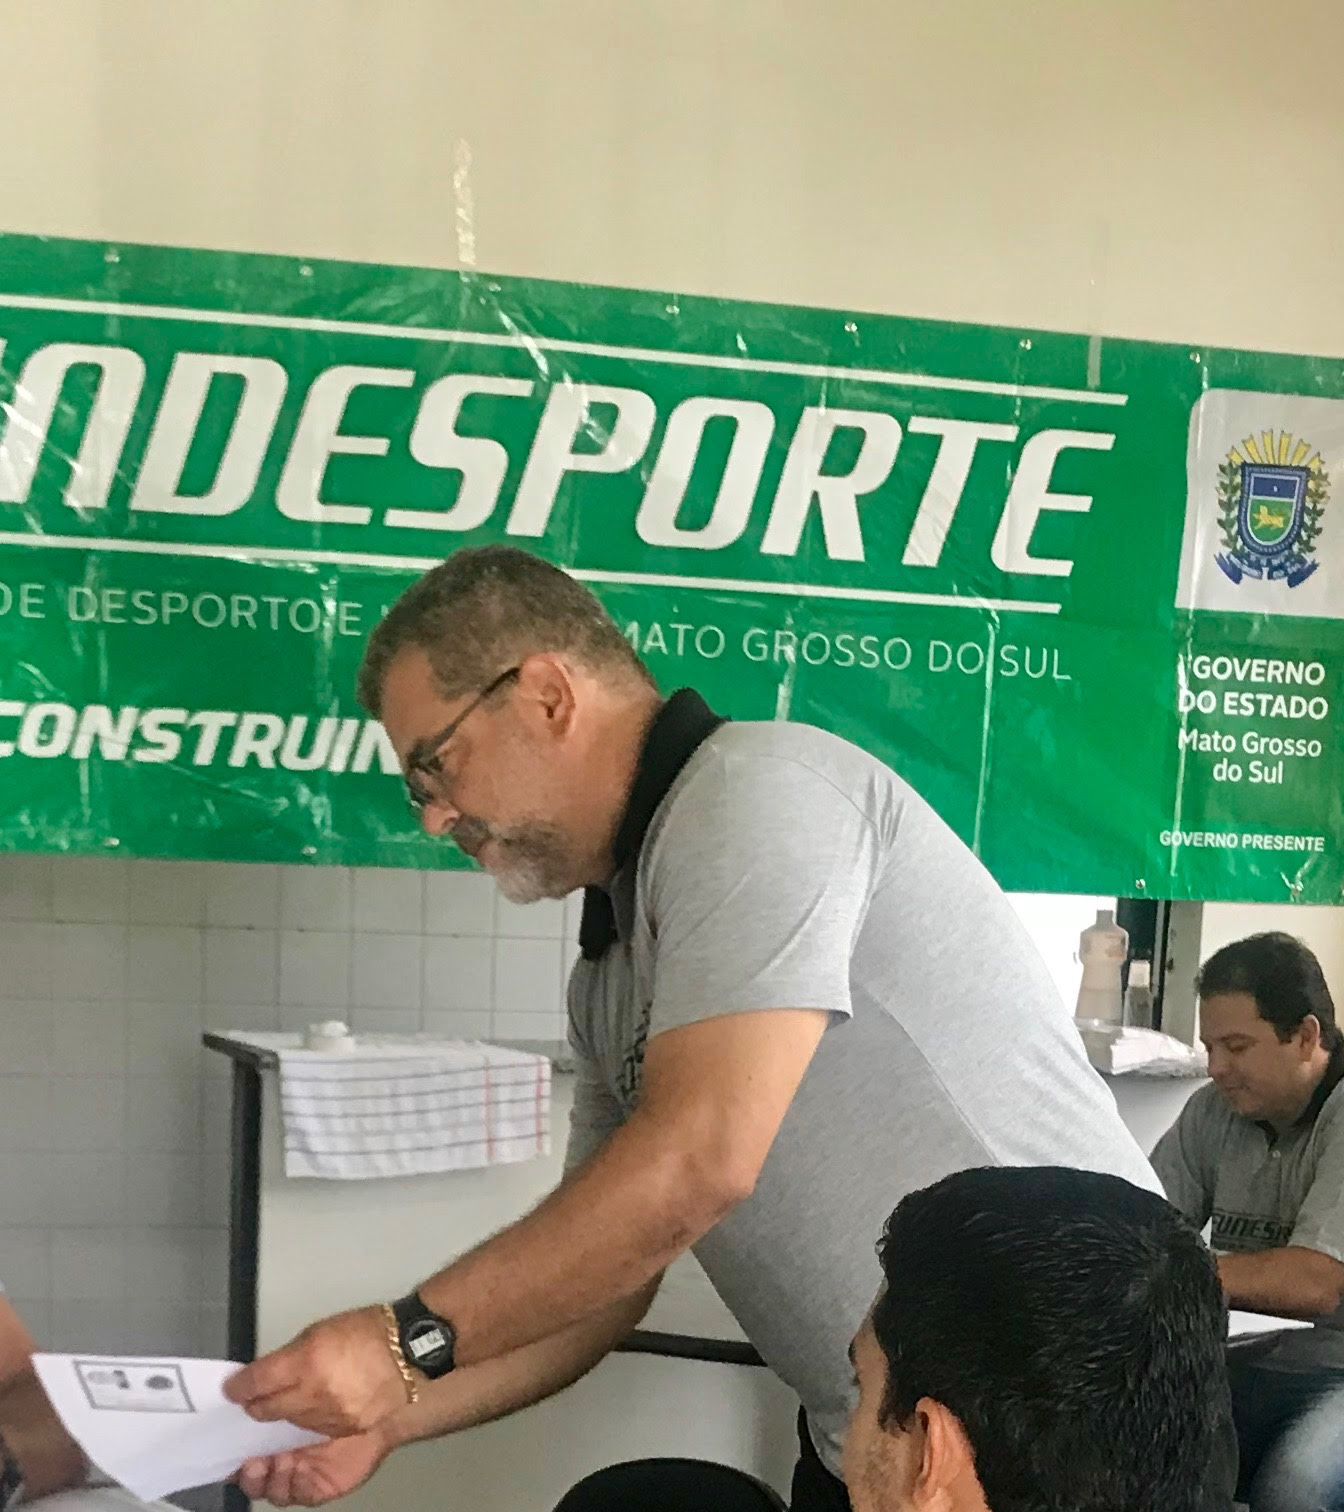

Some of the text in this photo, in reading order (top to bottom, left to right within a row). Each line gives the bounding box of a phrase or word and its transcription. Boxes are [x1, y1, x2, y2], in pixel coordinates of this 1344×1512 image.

[68, 586, 321, 633] DESPORTO
[338, 601, 363, 636] E
[742, 629, 912, 671] GROSSO
[928, 640, 984, 674] DO
[999, 644, 1071, 680] SUL
[1193, 655, 1325, 685] GOVERNO
[1177, 688, 1328, 720] DO ESTADO
[1177, 728, 1322, 757] Mato Grosso
[1213, 758, 1283, 784] do Sul
[1159, 830, 1325, 852] GOVERNO PRESENTE
